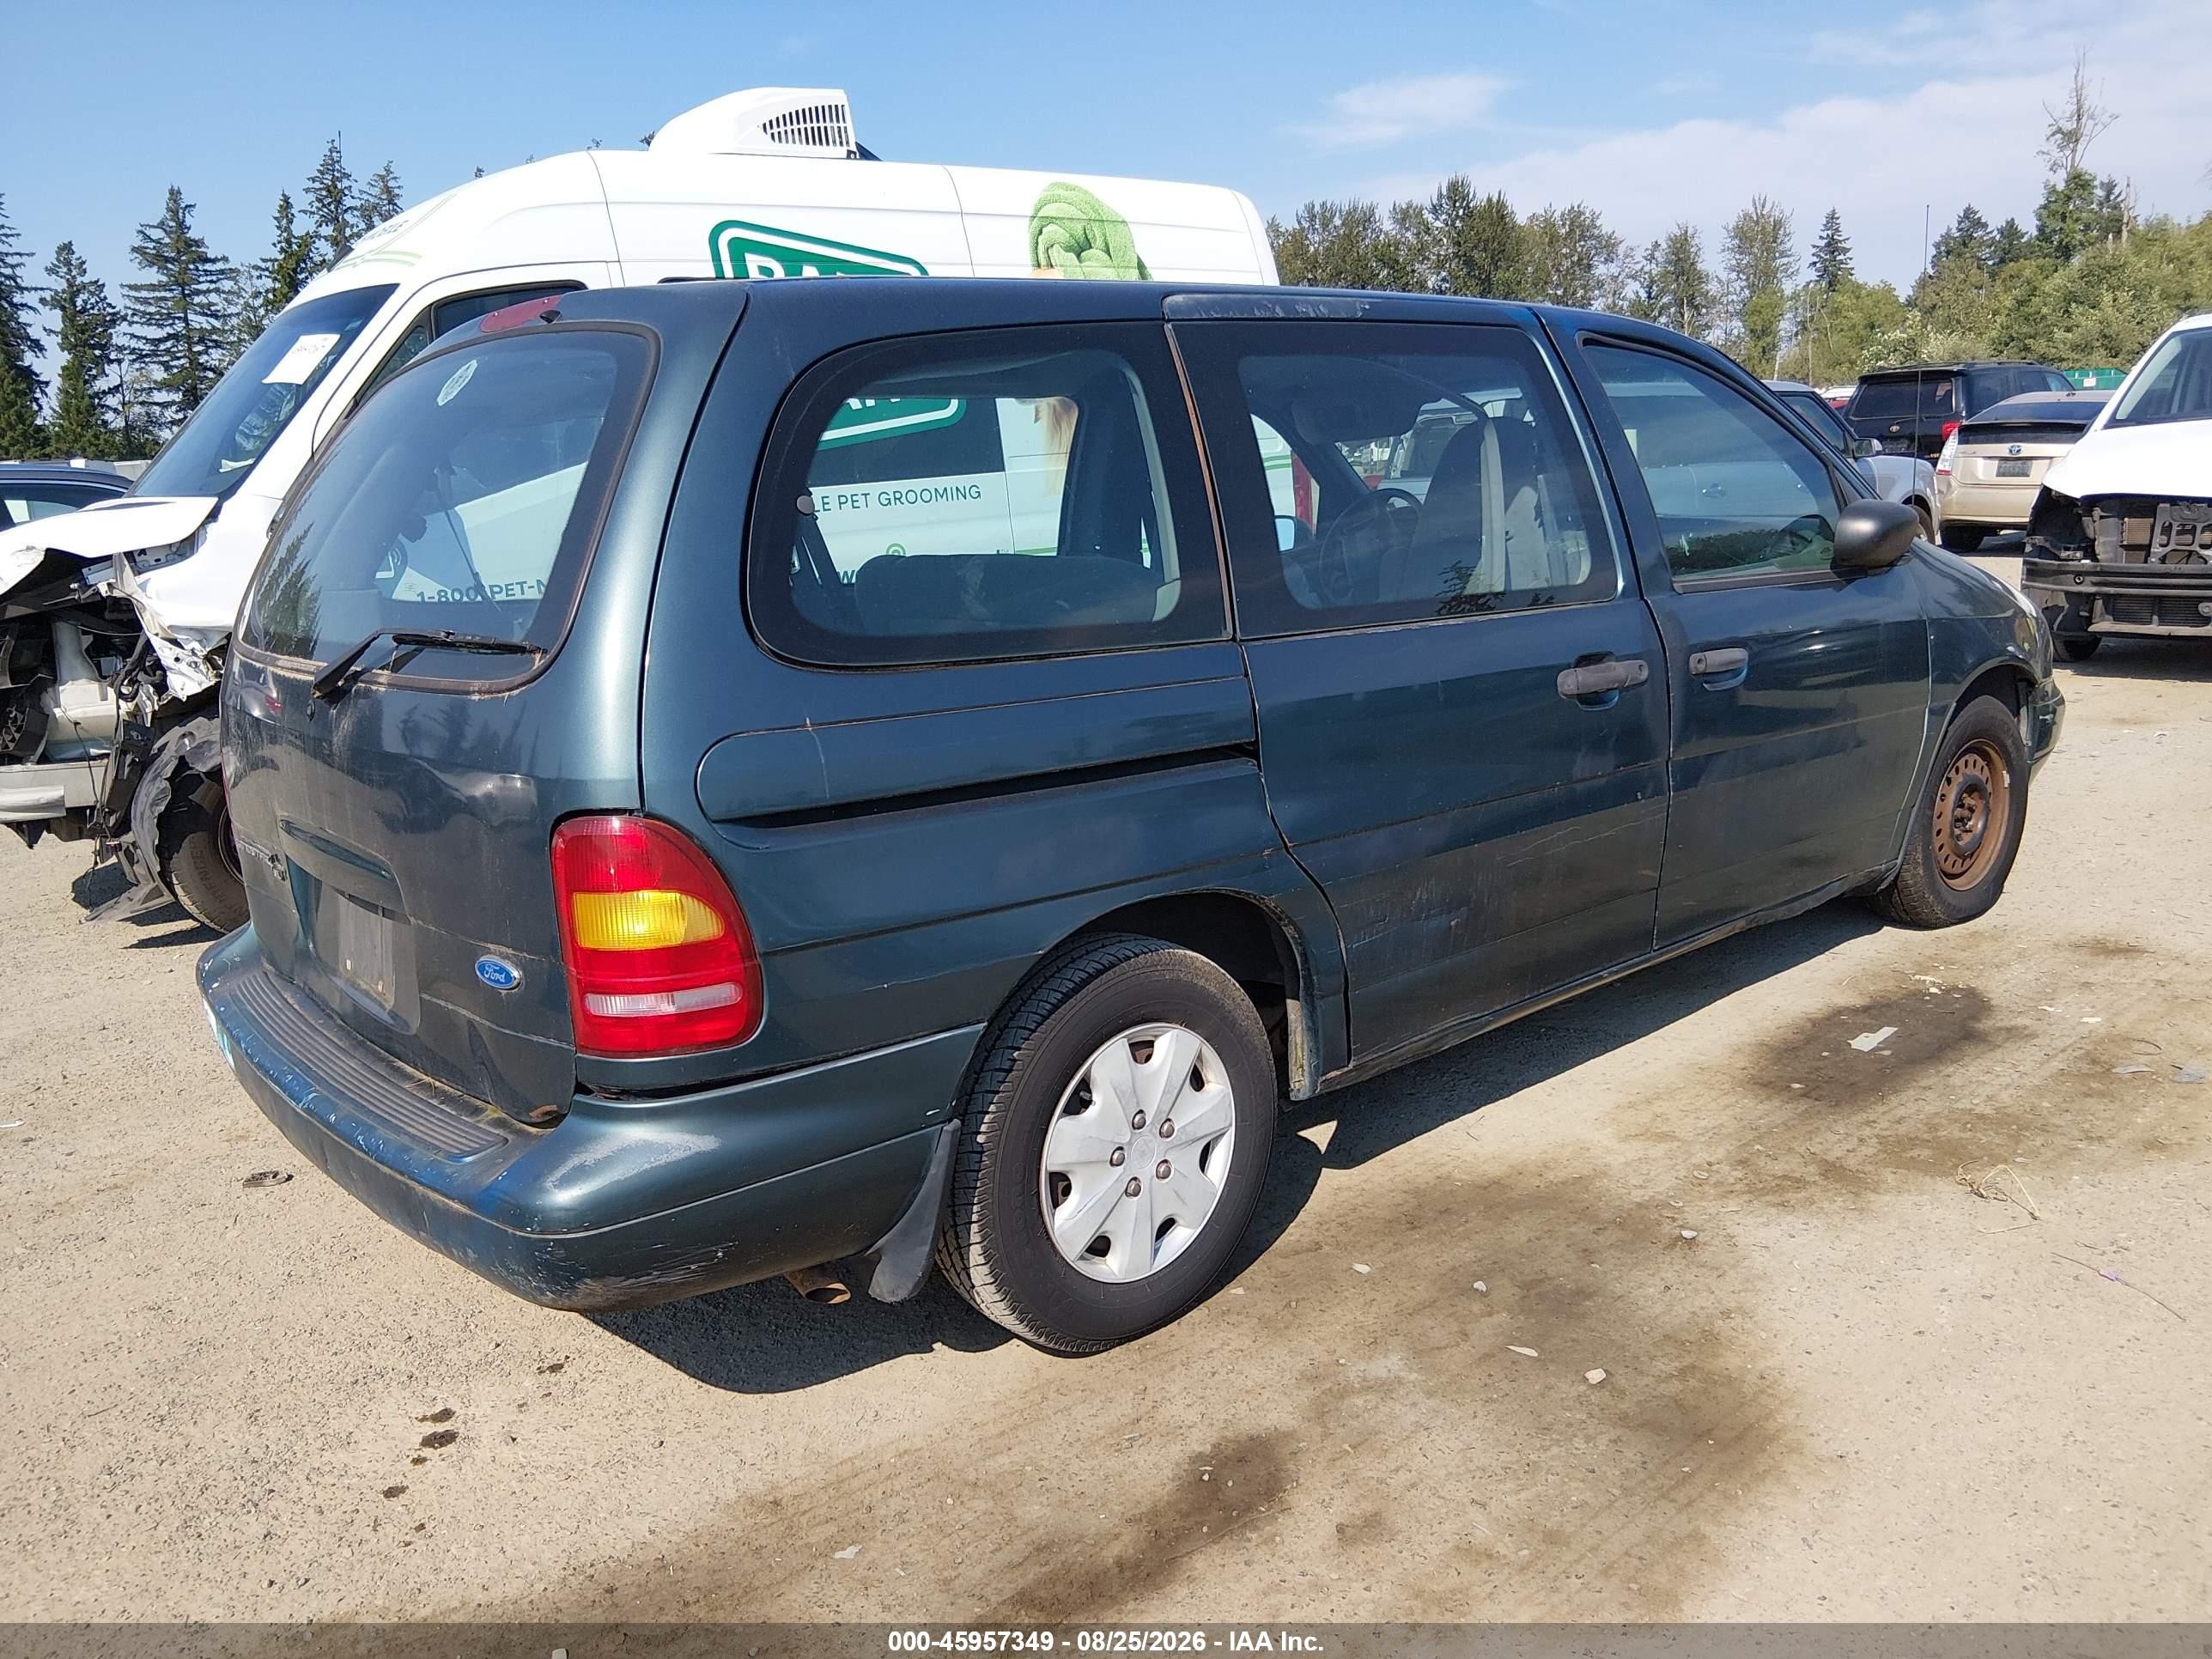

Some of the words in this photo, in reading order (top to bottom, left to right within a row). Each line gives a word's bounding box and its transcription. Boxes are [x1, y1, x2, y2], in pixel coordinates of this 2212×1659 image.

[838, 493, 871, 511] PET
[878, 484, 981, 507] GROOMING
[483, 963, 506, 982] Ford
